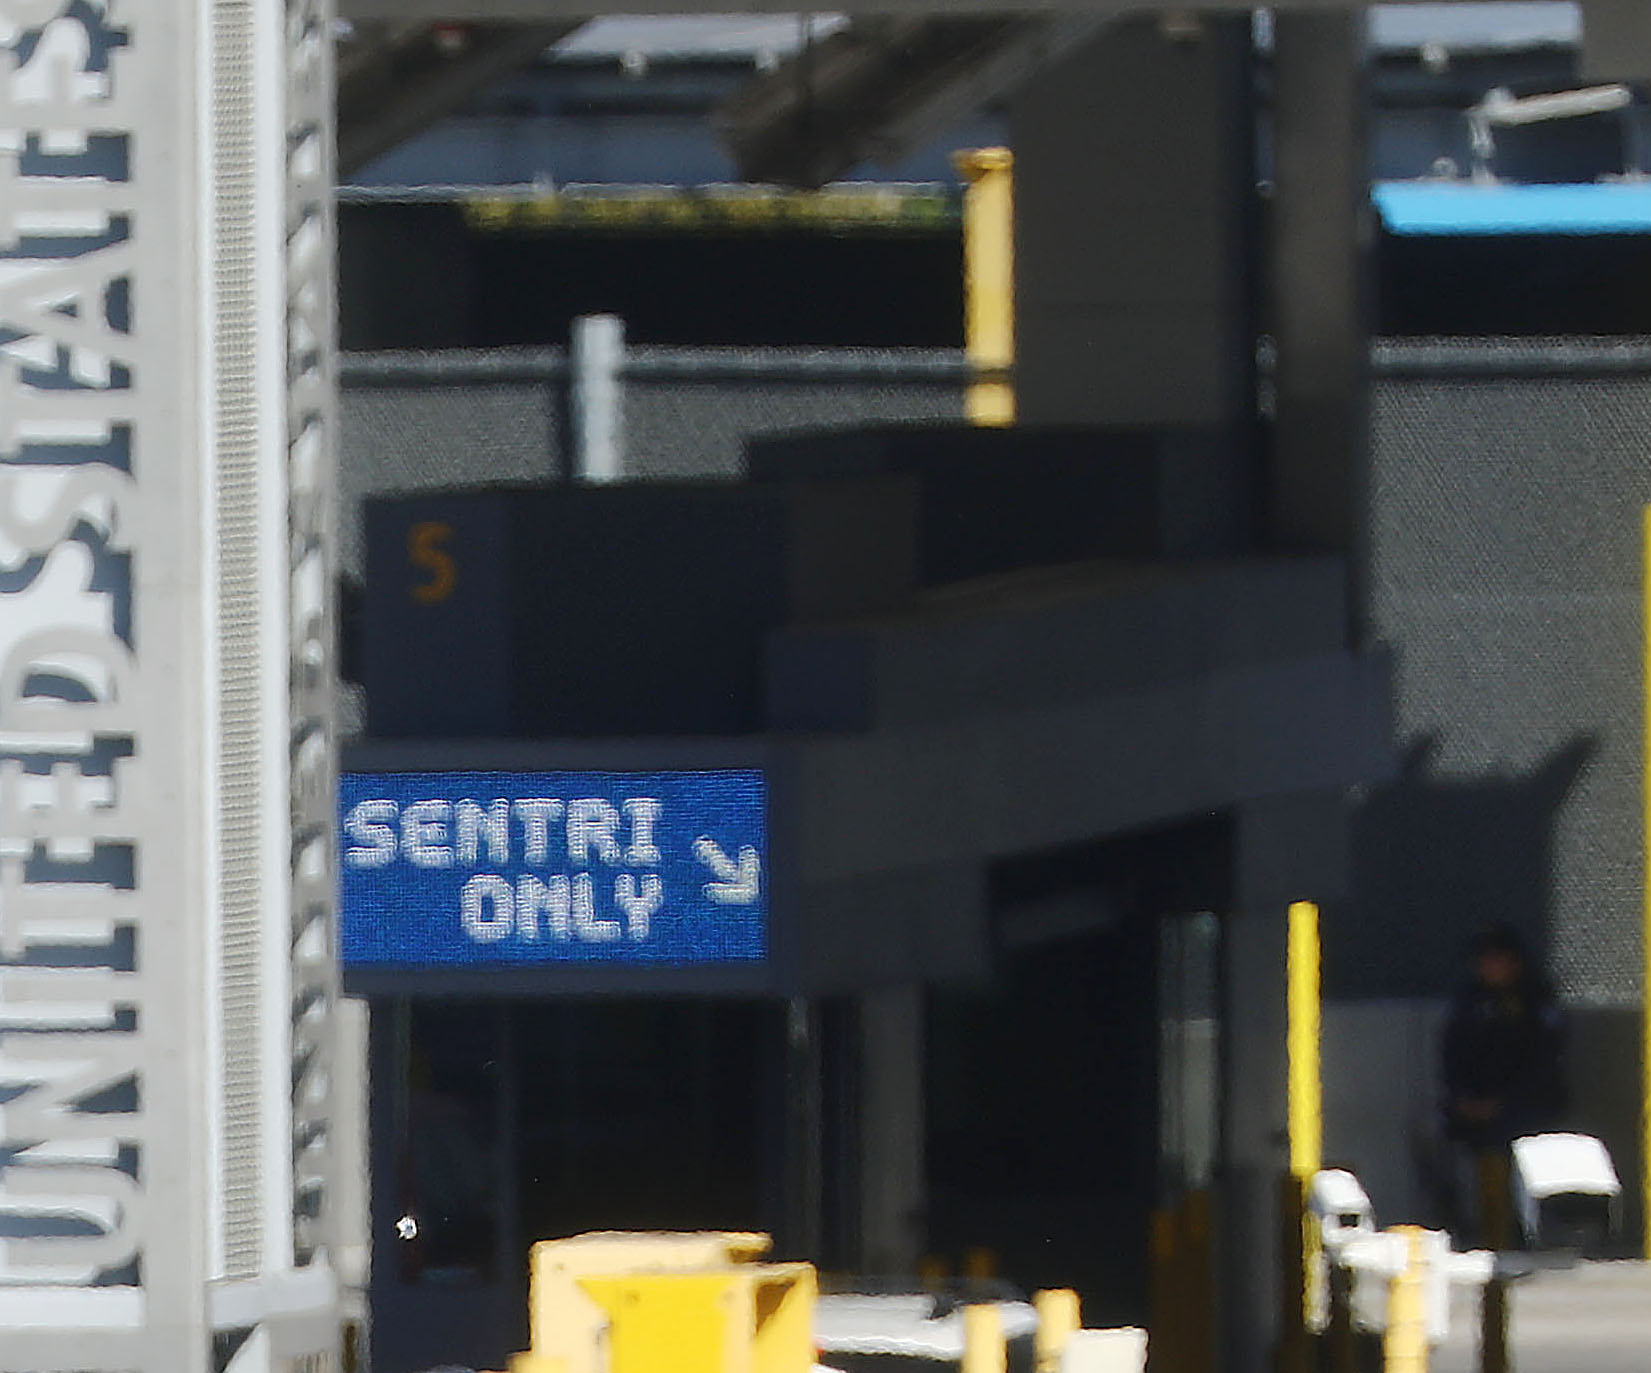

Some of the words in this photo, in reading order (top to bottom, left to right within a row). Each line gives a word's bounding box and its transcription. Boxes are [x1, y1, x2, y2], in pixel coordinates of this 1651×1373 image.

[409, 523, 458, 602] 5
[342, 797, 664, 867] SENTRI
[459, 873, 664, 943] ONLY
